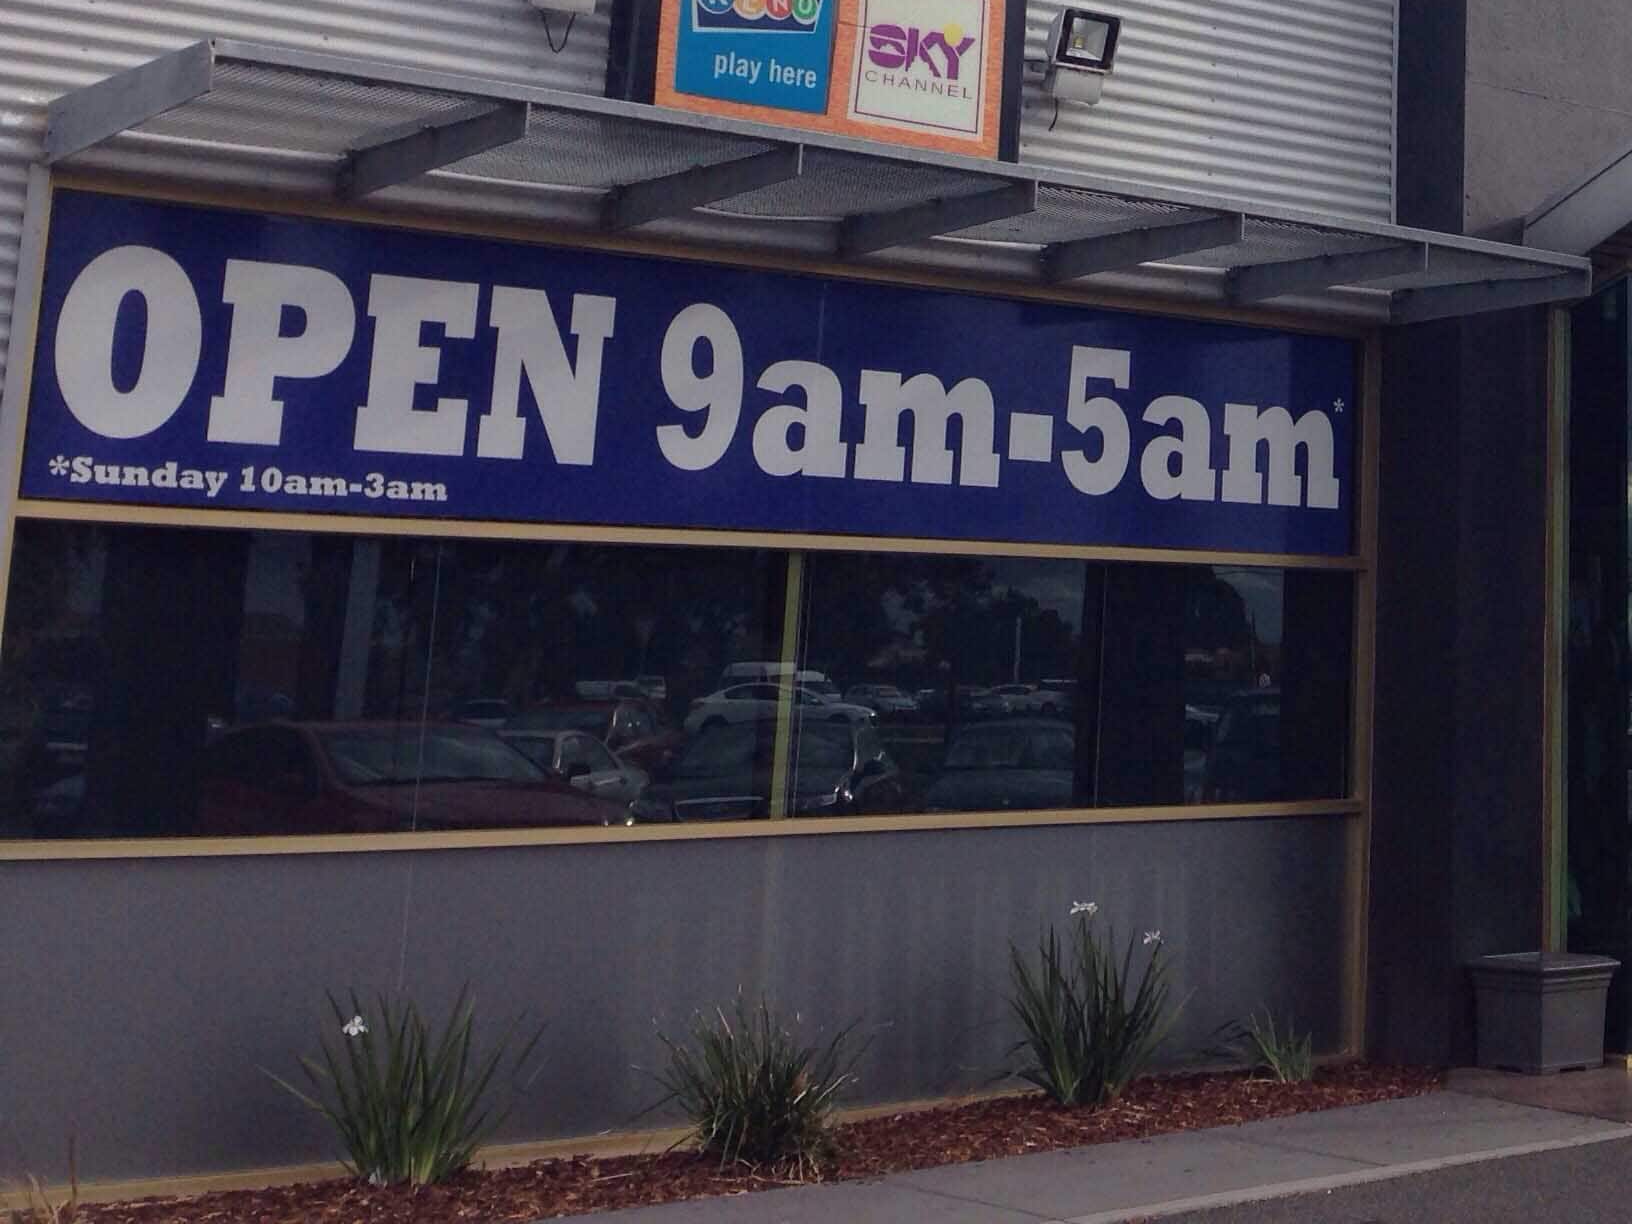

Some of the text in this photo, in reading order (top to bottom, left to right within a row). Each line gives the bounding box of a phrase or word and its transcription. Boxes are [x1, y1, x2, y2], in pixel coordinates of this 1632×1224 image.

[713, 50, 818, 89] play here
[869, 23, 975, 80] SKY
[864, 69, 974, 101] CHANNEL
[54, 244, 617, 466] OPEN
[240, 466, 449, 502] 10am-3am
